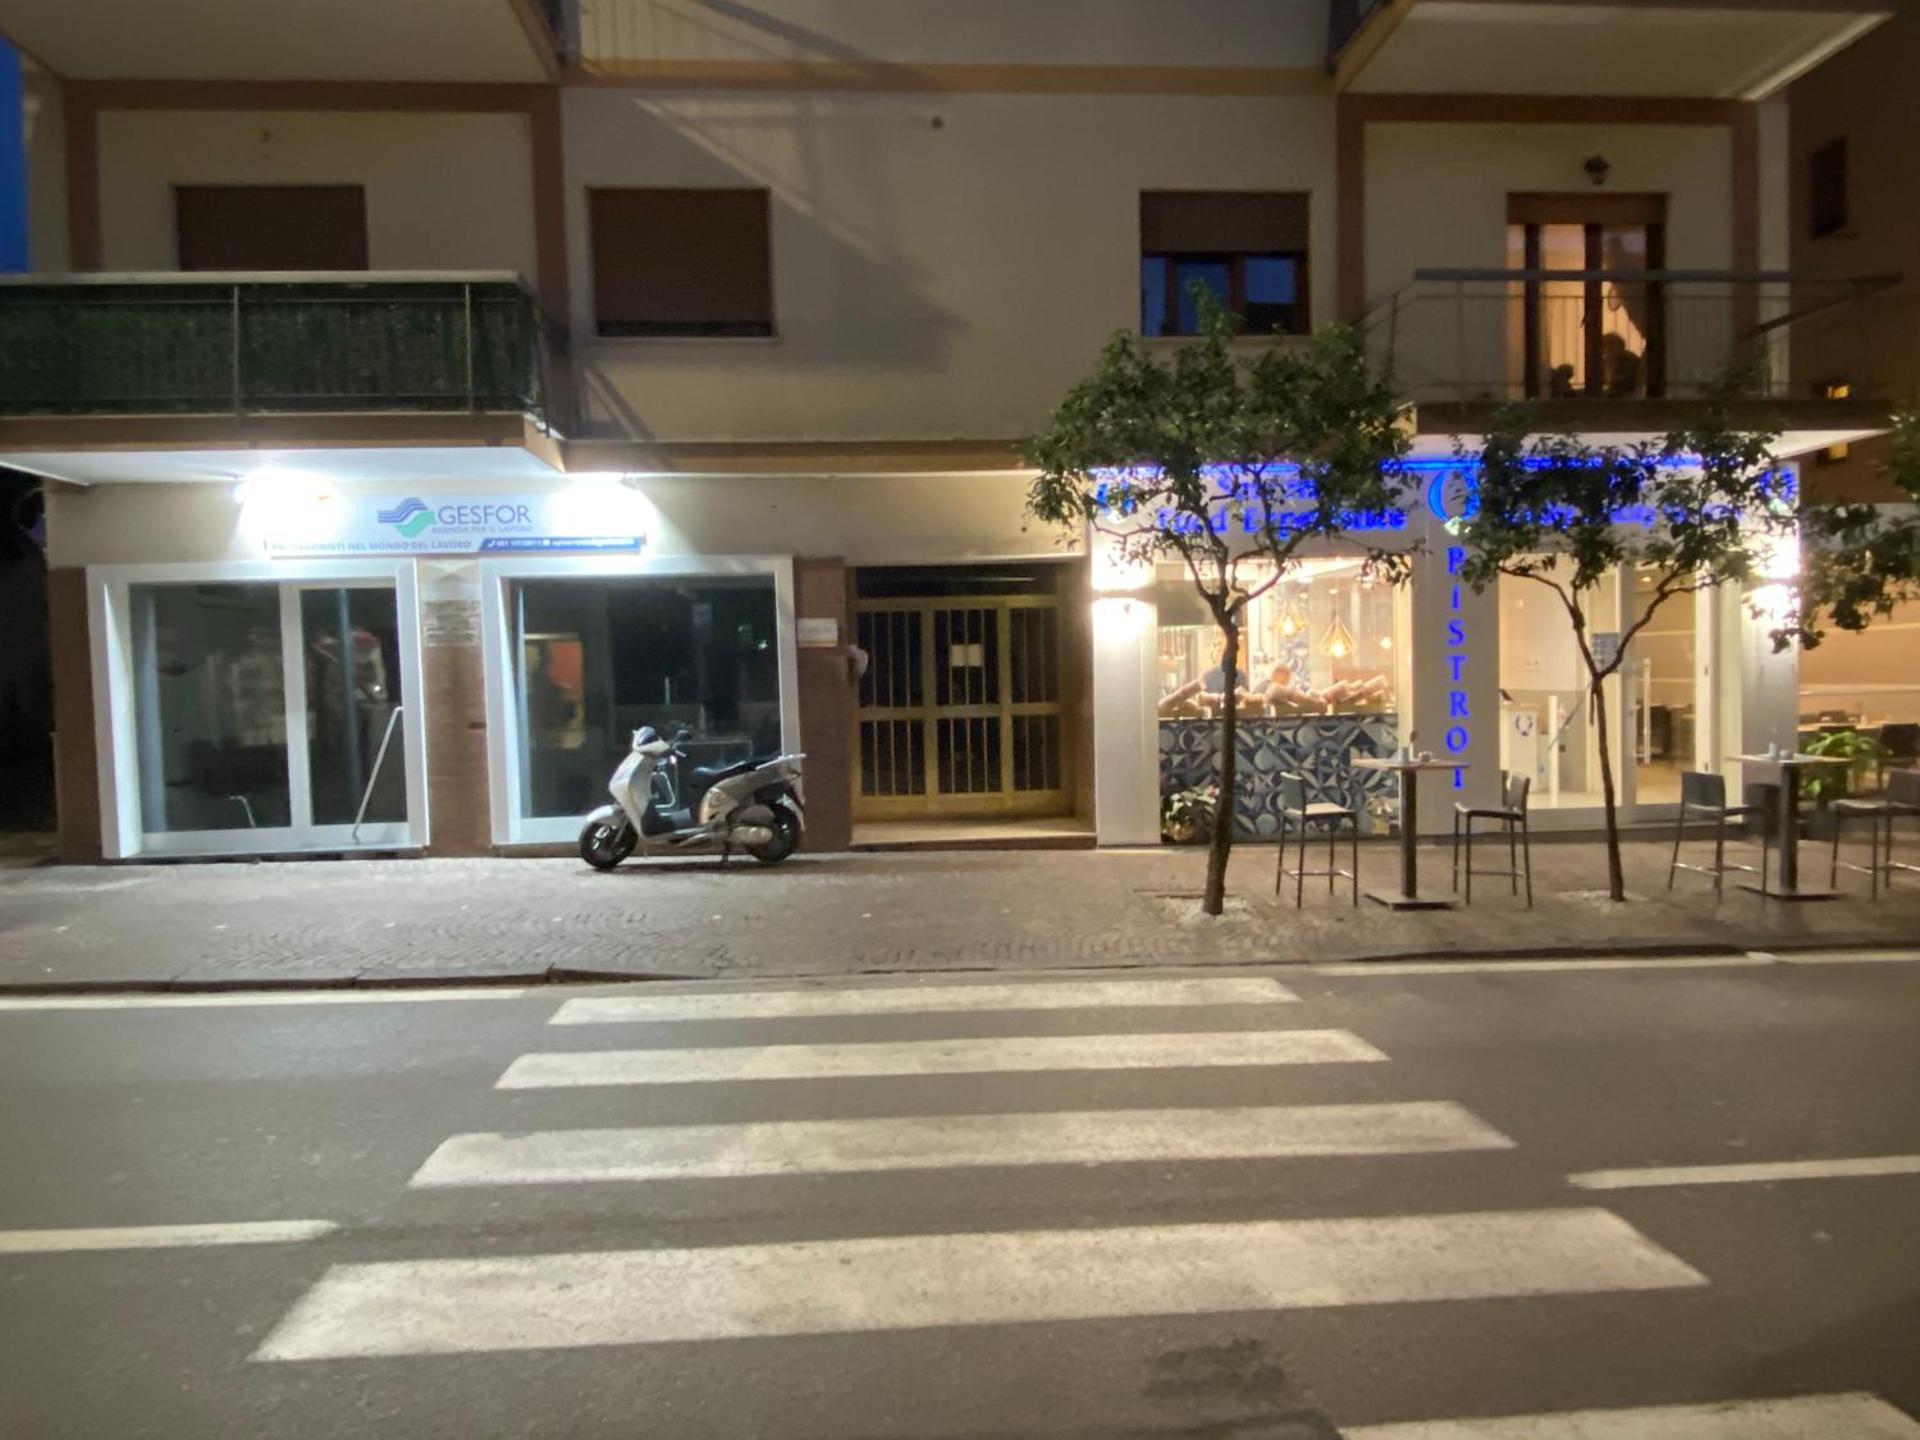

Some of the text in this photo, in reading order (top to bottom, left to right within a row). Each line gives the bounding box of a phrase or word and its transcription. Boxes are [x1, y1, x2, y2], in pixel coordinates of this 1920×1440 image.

[438, 505, 532, 525] GESFOR
[347, 542, 367, 551] NEL
[369, 542, 408, 551] MONDO
[411, 541, 428, 550] DEL
[432, 540, 472, 550] LAVORO
